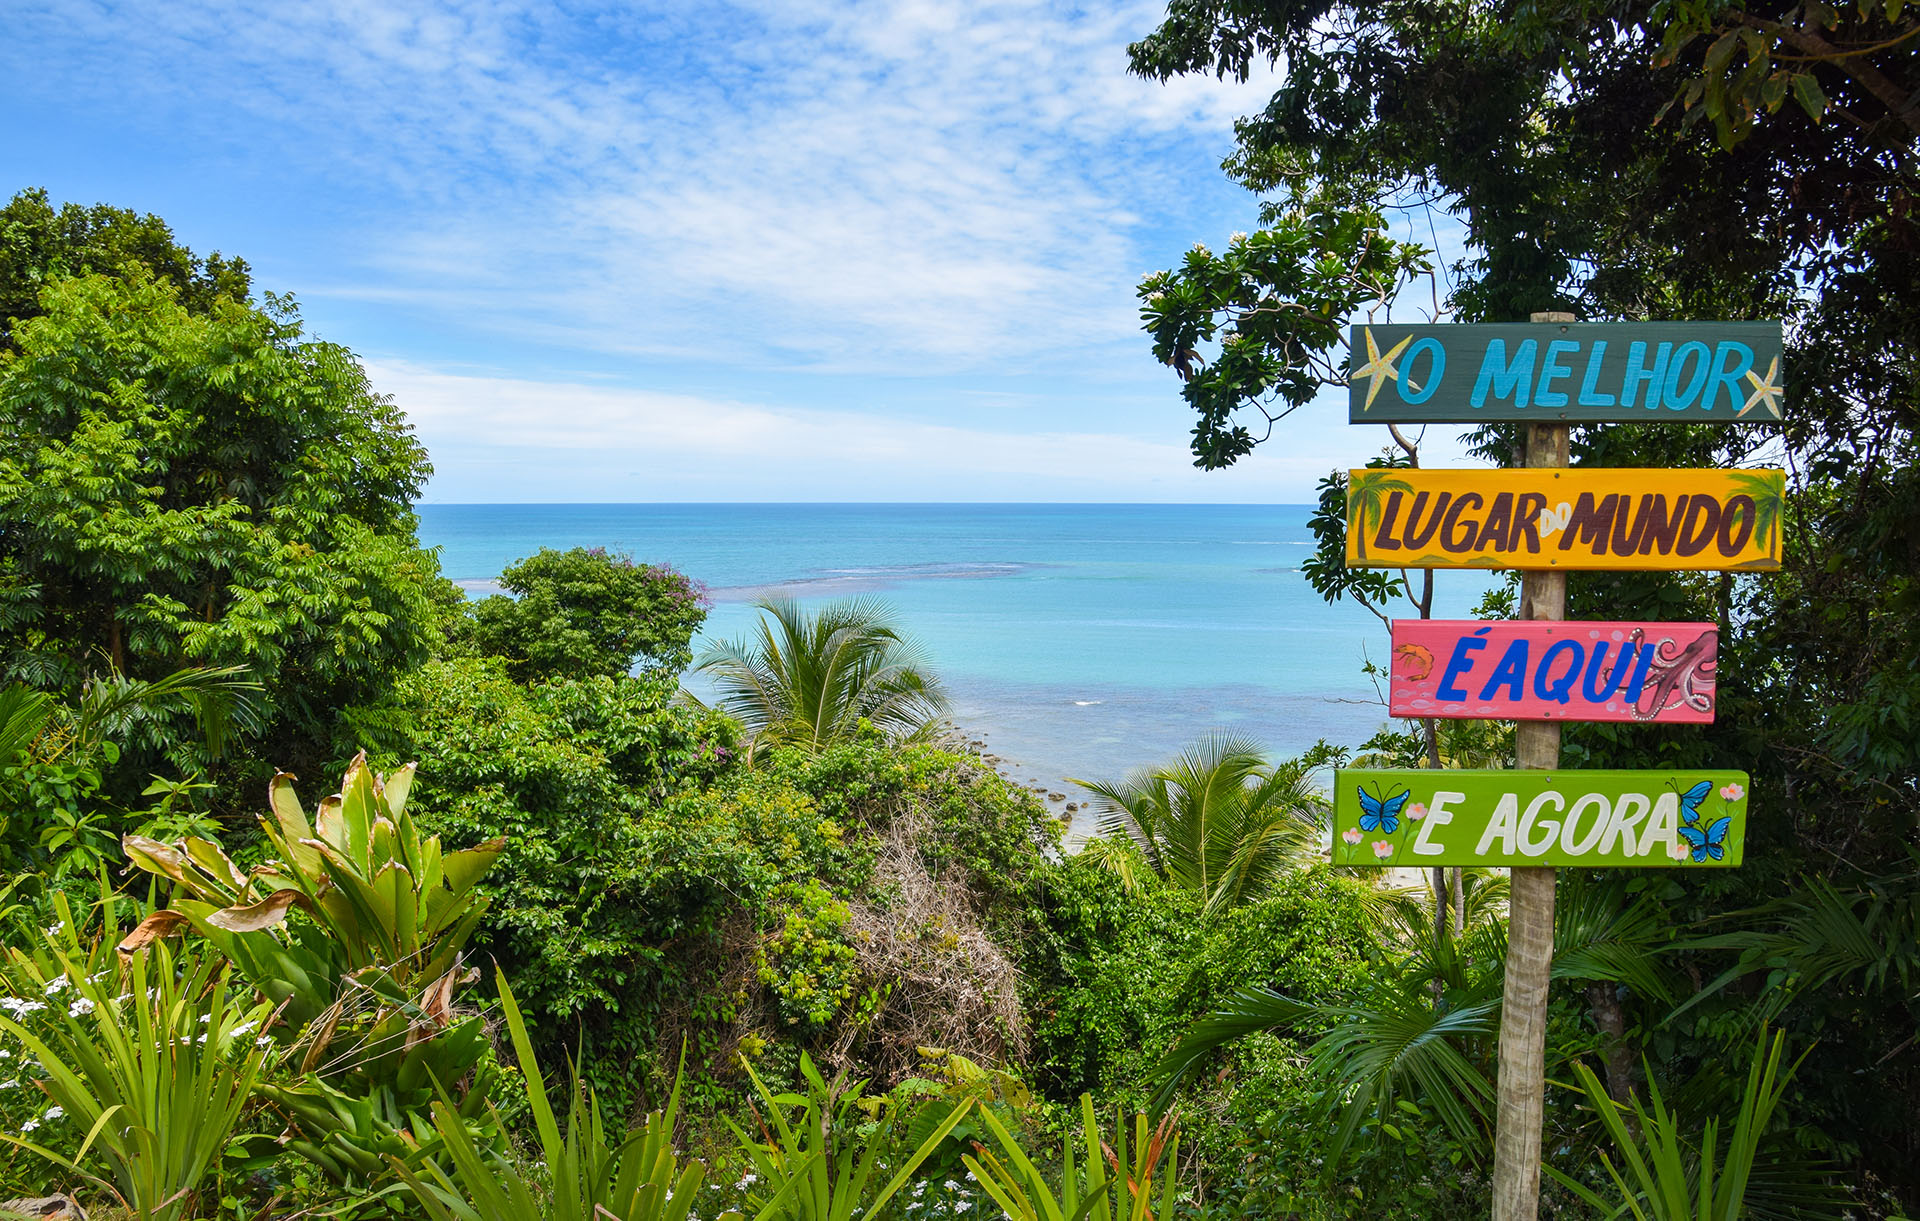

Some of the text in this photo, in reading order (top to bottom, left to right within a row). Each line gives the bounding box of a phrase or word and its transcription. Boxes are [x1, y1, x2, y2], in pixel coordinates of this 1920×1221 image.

[1396, 337, 1754, 412] O MELHOR
[1374, 491, 1756, 557] LUGAR DO MUNDO
[1413, 790, 1679, 858] E AGORA
